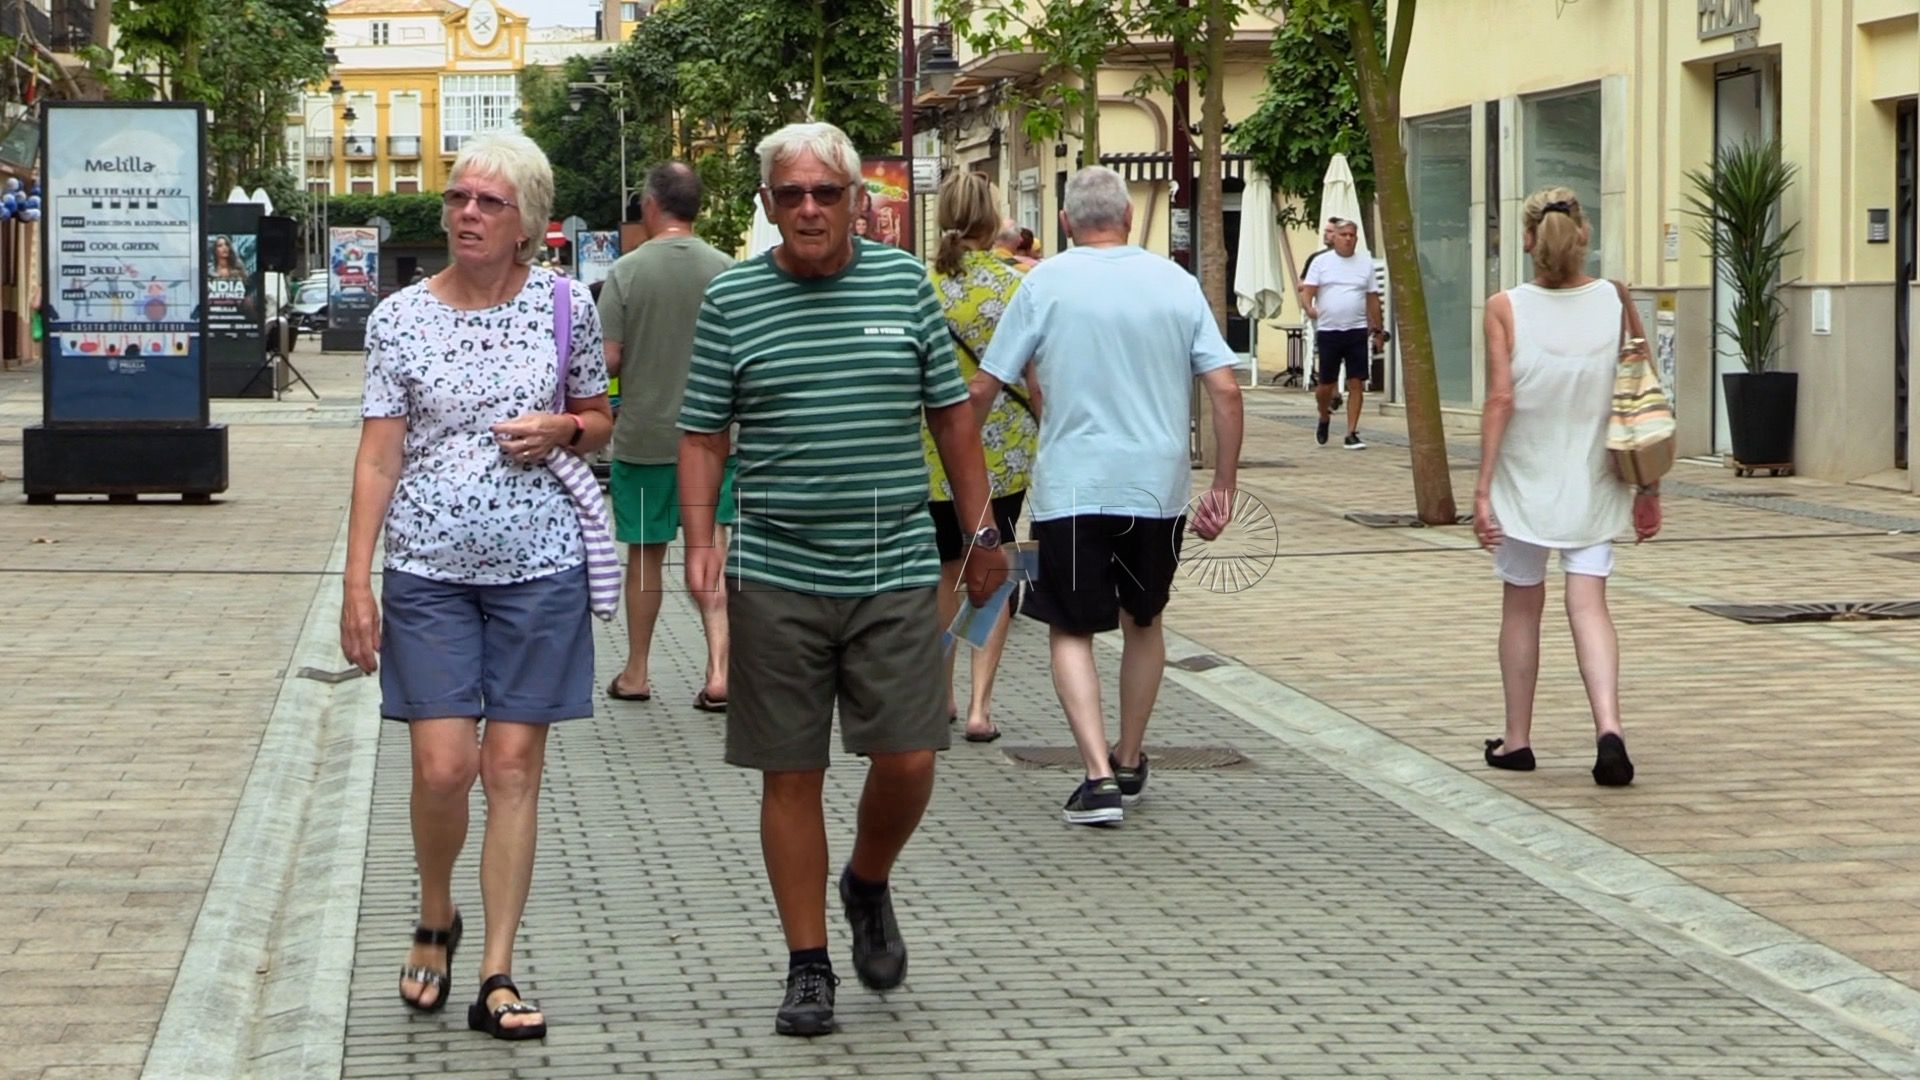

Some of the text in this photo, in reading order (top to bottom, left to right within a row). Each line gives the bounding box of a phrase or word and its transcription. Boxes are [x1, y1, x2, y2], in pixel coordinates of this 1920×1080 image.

[85, 155, 156, 173] Melilla
[89, 242, 118, 251] COOL
[122, 242, 160, 251] GREEN
[207, 280, 246, 292] NDIA
